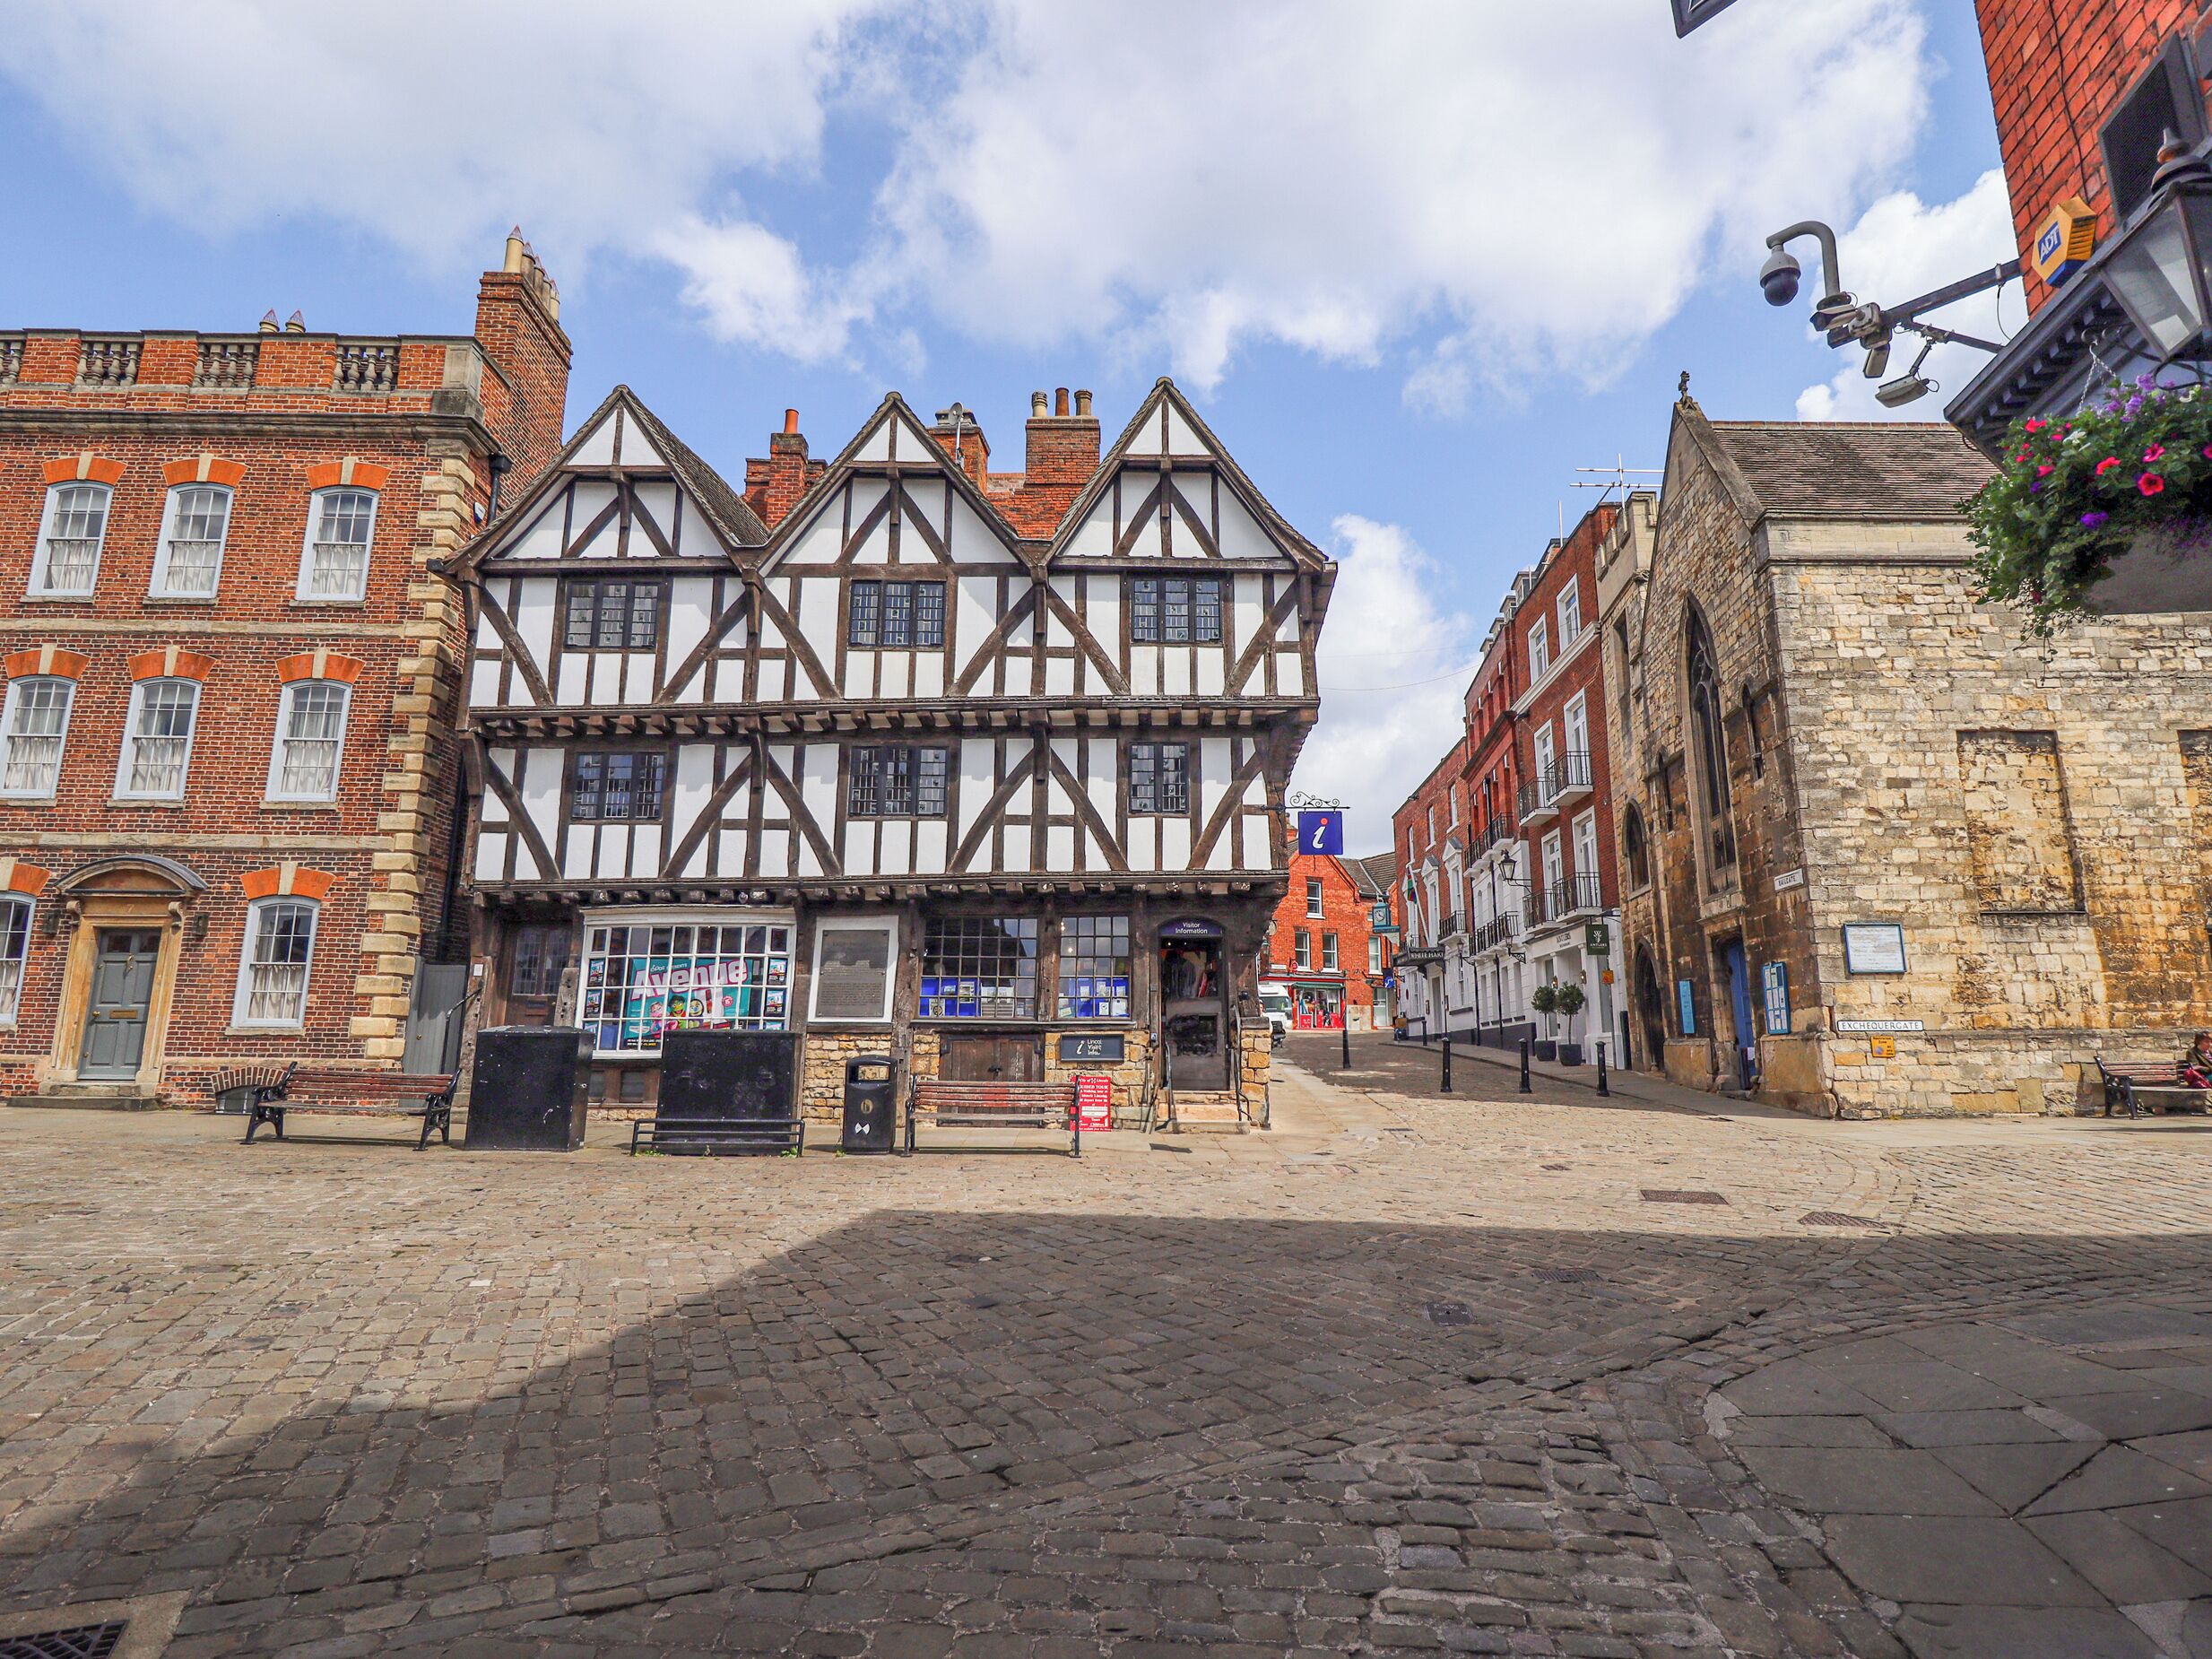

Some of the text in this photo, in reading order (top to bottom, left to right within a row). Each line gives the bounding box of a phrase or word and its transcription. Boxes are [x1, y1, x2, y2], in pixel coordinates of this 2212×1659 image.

[2040, 225, 2059, 260] ADT
[631, 960, 748, 1001] Avenue
[1842, 1021, 1920, 1029] EXCHEQUERGATE
